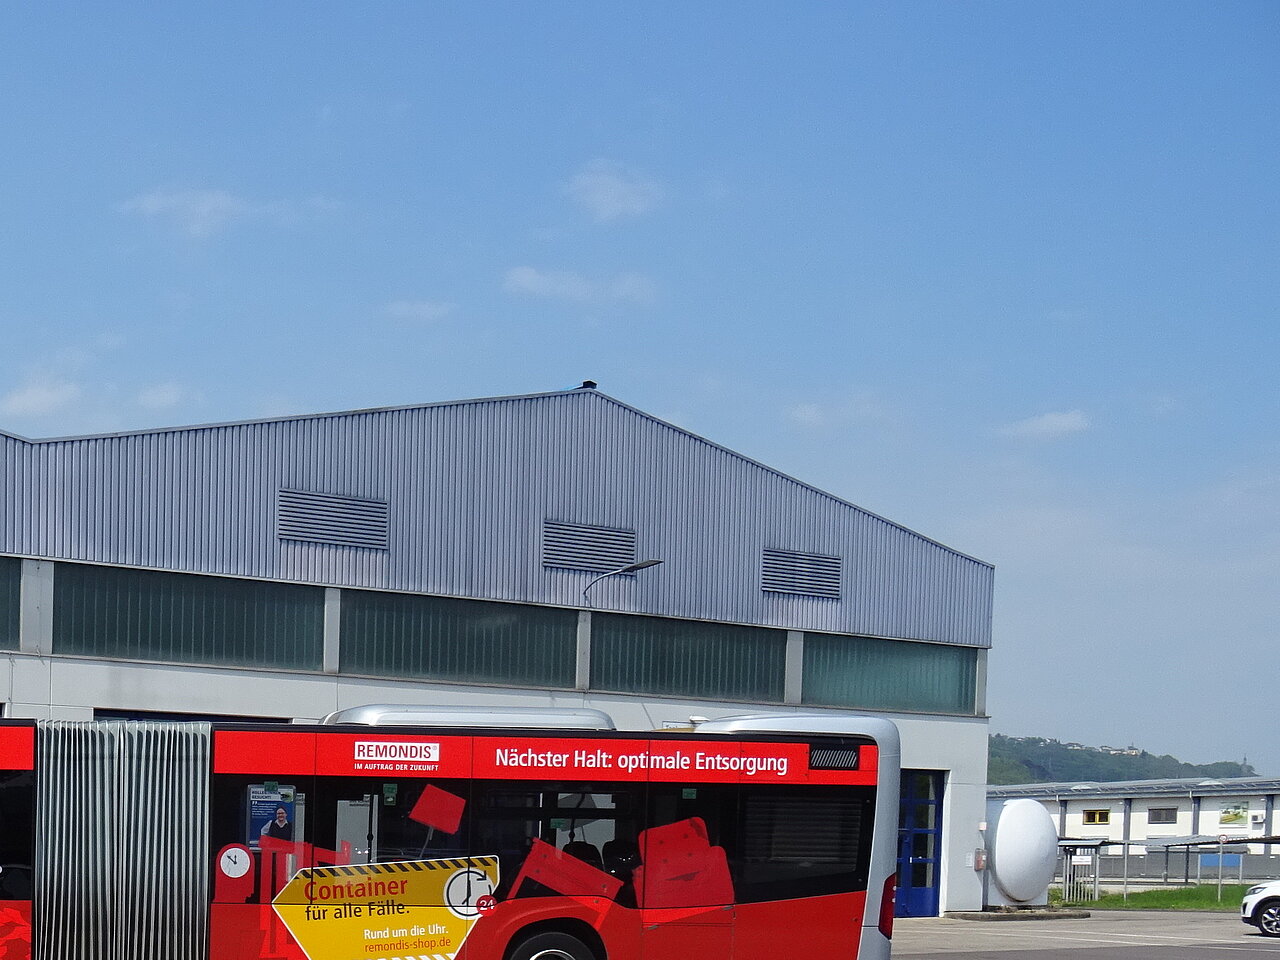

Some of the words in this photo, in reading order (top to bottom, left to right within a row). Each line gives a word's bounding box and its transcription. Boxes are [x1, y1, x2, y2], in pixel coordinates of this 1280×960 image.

[495, 748, 569, 768] Nächster
[573, 750, 612, 768] Halt:
[617, 750, 690, 773] optimale
[695, 752, 788, 776] Entsorgung
[304, 877, 408, 901] Container
[305, 904, 328, 921] für
[333, 902, 362, 919] alle
[368, 899, 411, 916] Fälle.
[480, 899, 495, 910] 24
[363, 926, 390, 939] Rund
[392, 928, 408, 938] um
[410, 924, 426, 936] die
[428, 923, 449, 935] Uhr.
[364, 936, 452, 953] remondis-shop.de
